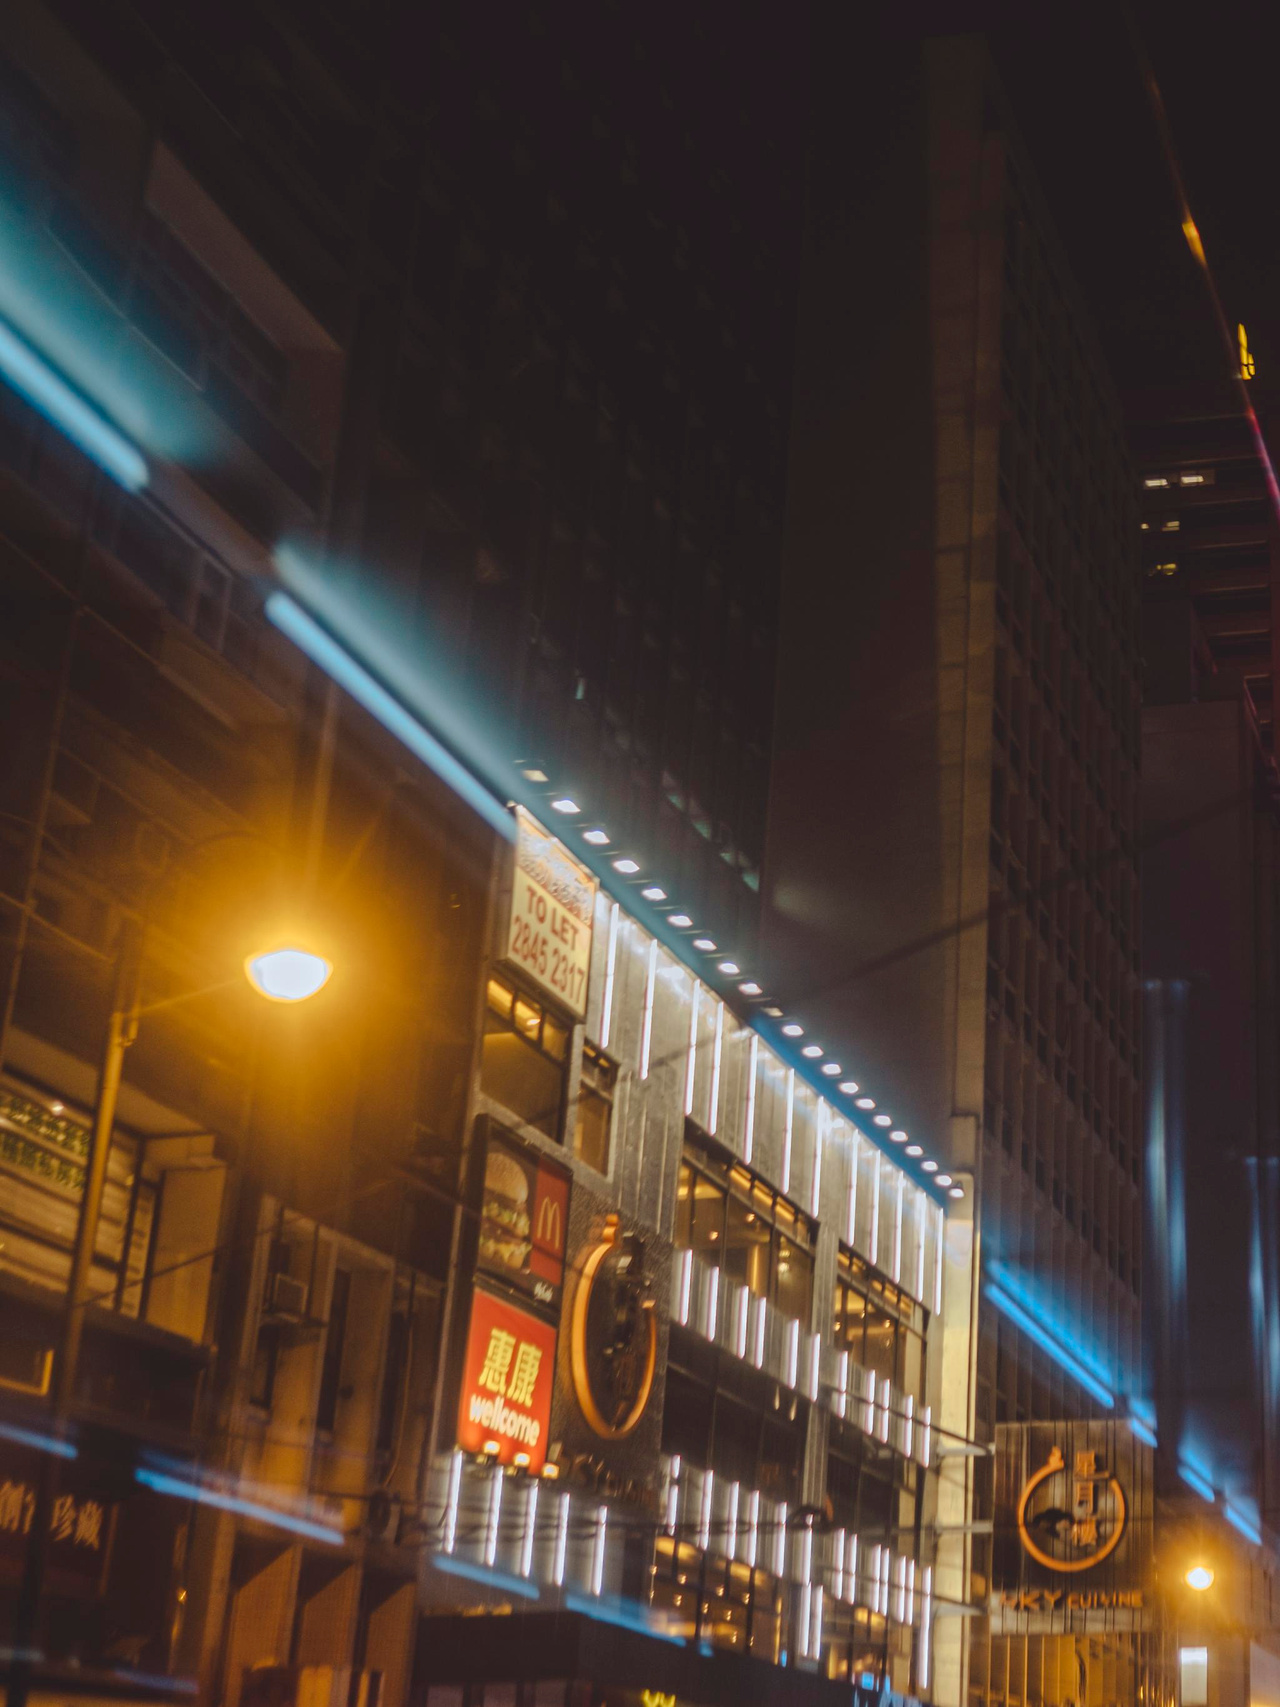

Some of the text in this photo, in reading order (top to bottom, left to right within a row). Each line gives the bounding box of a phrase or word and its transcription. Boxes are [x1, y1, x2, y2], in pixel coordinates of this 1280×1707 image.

[527, 884, 548, 925] TO
[551, 908, 580, 951] LET
[512, 915, 585, 1004] 2845 2317
[478, 1327, 543, 1408] 惠康
[469, 1393, 541, 1447] wellcome
